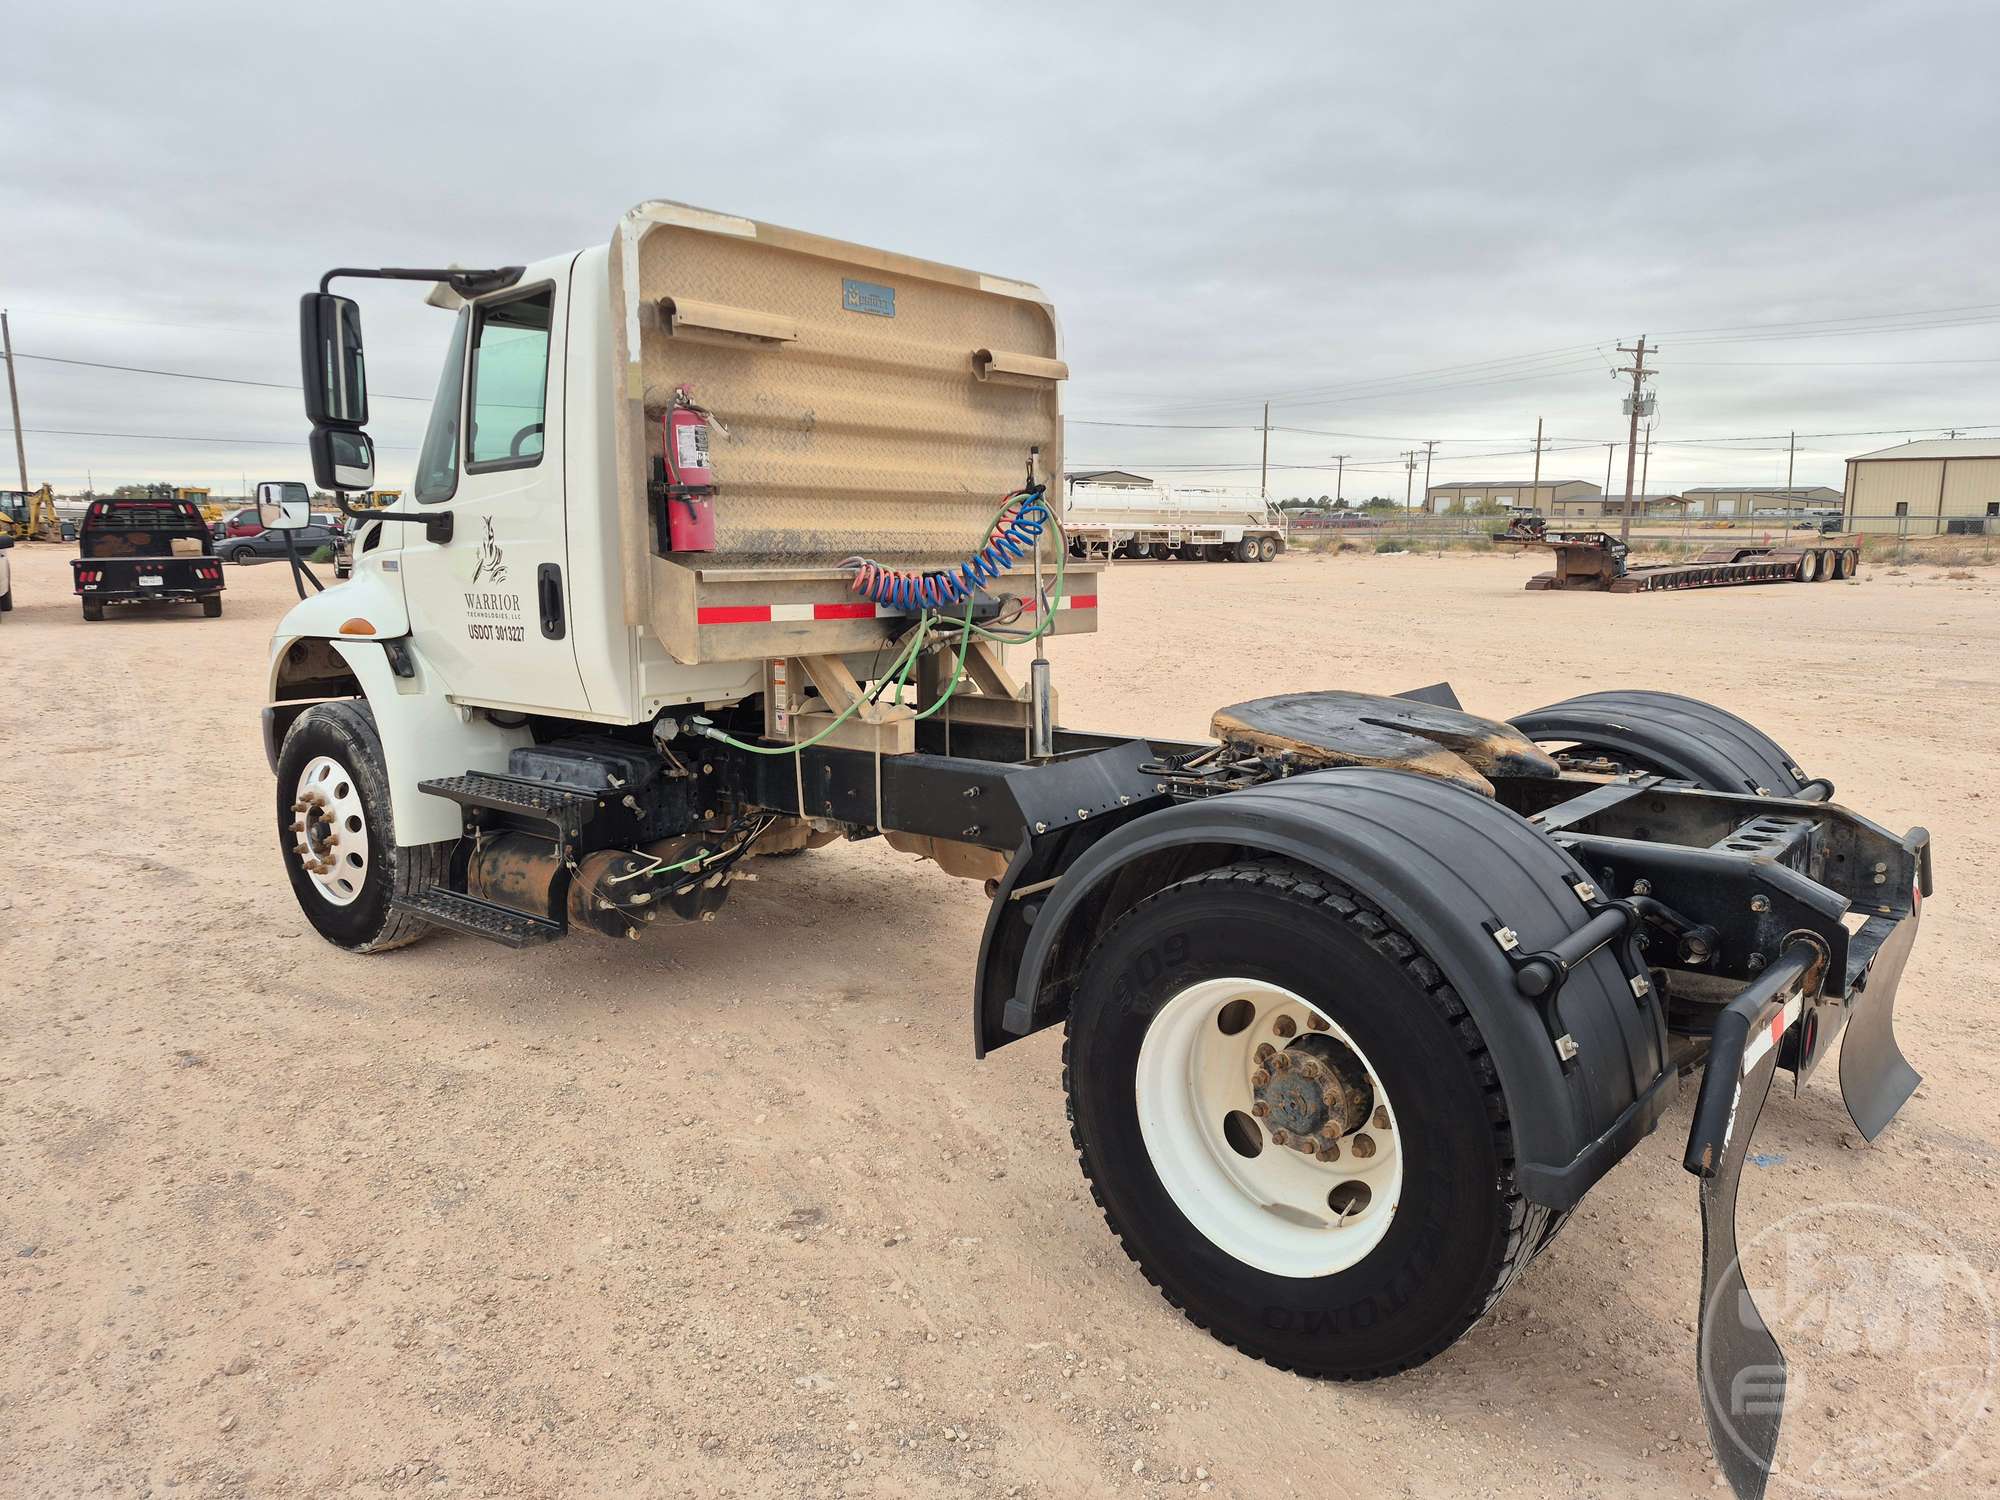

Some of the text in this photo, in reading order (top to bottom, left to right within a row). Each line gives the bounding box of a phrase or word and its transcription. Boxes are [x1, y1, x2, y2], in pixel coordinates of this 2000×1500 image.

[464, 593, 521, 611] WARRIOR
[467, 624, 525, 642] USDOT 3013227
